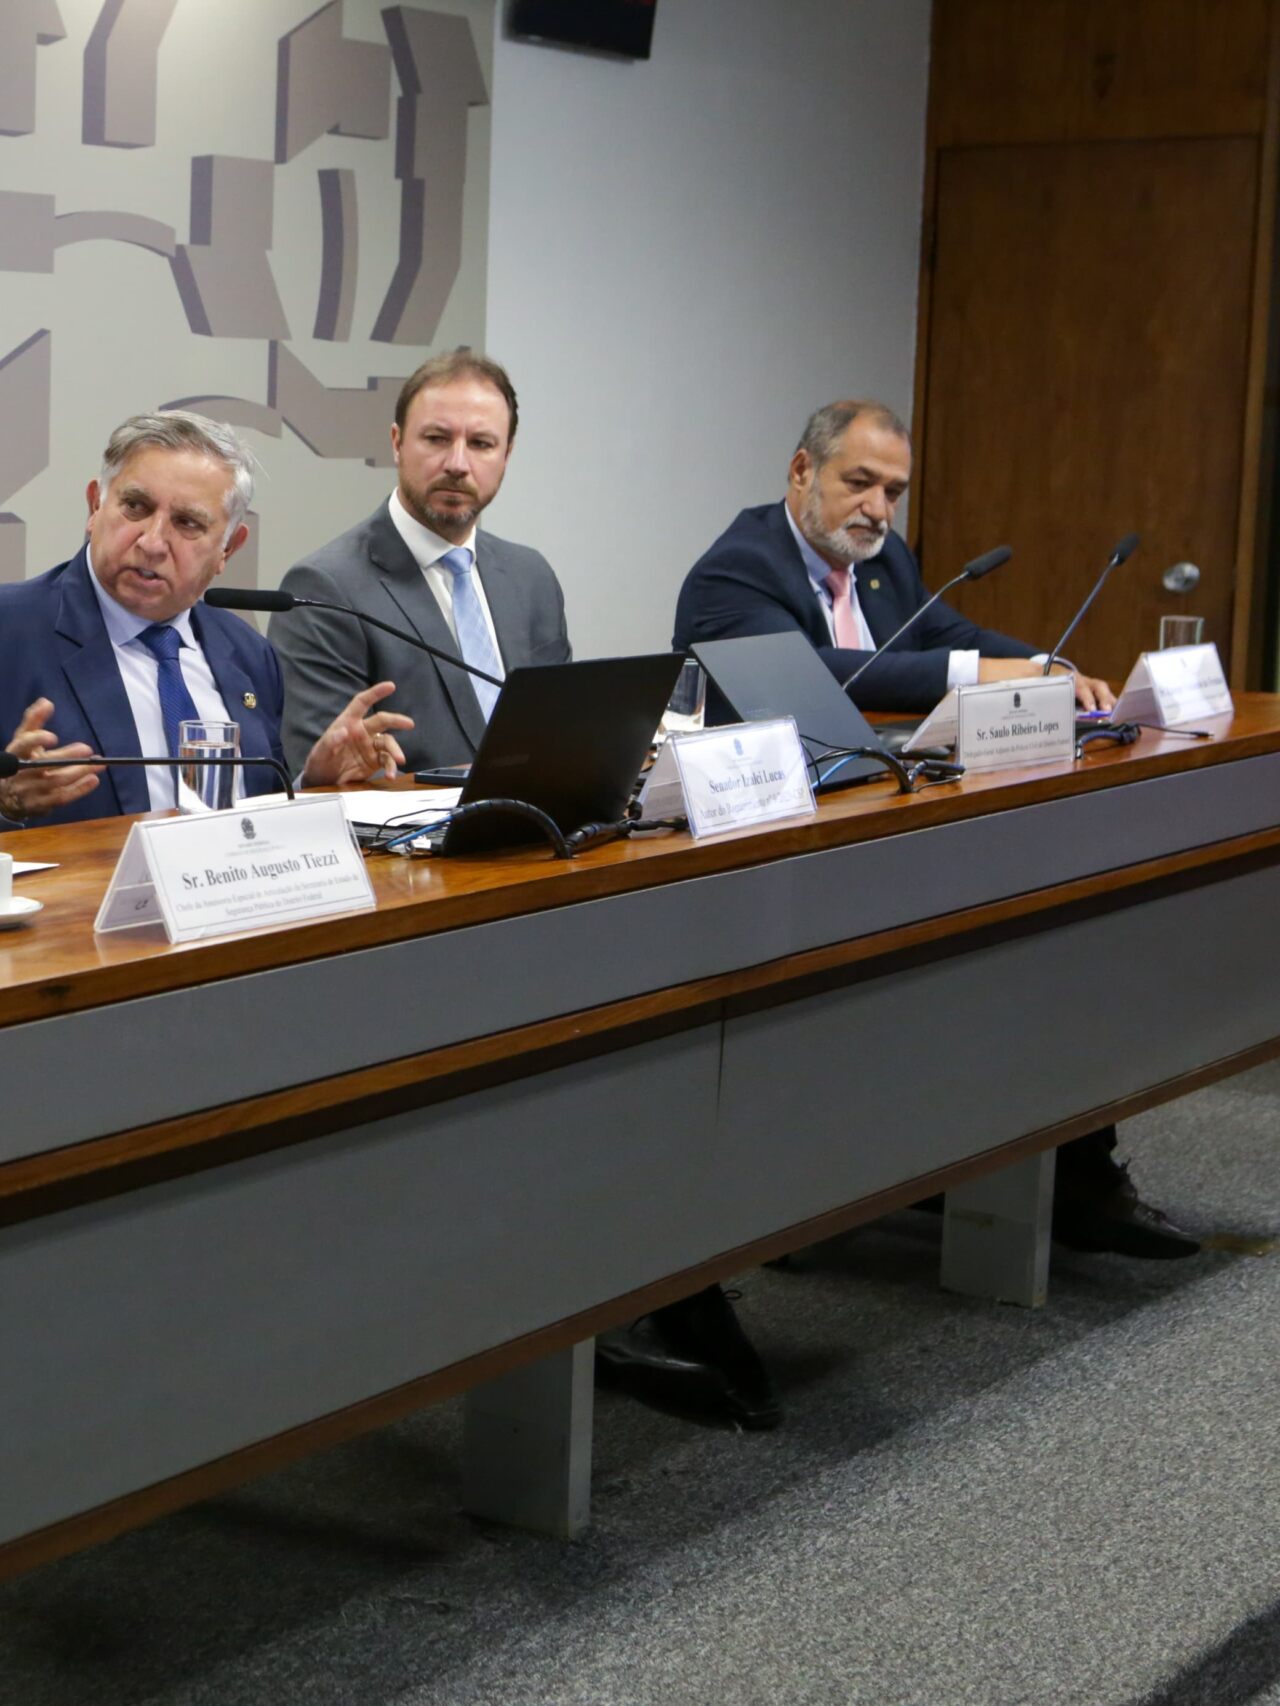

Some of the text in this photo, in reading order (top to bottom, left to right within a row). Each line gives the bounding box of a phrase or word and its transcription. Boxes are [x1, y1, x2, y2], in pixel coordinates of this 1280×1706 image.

[976, 720, 1060, 741] Sr. Saulo Ribeiro Lopes
[708, 775, 739, 795] Senador
[763, 769, 785, 784] Lucas
[182, 872, 204, 891] Sr.
[205, 863, 248, 886] Benito
[250, 857, 300, 879] Augusto
[301, 849, 340, 871] Tiezzi
